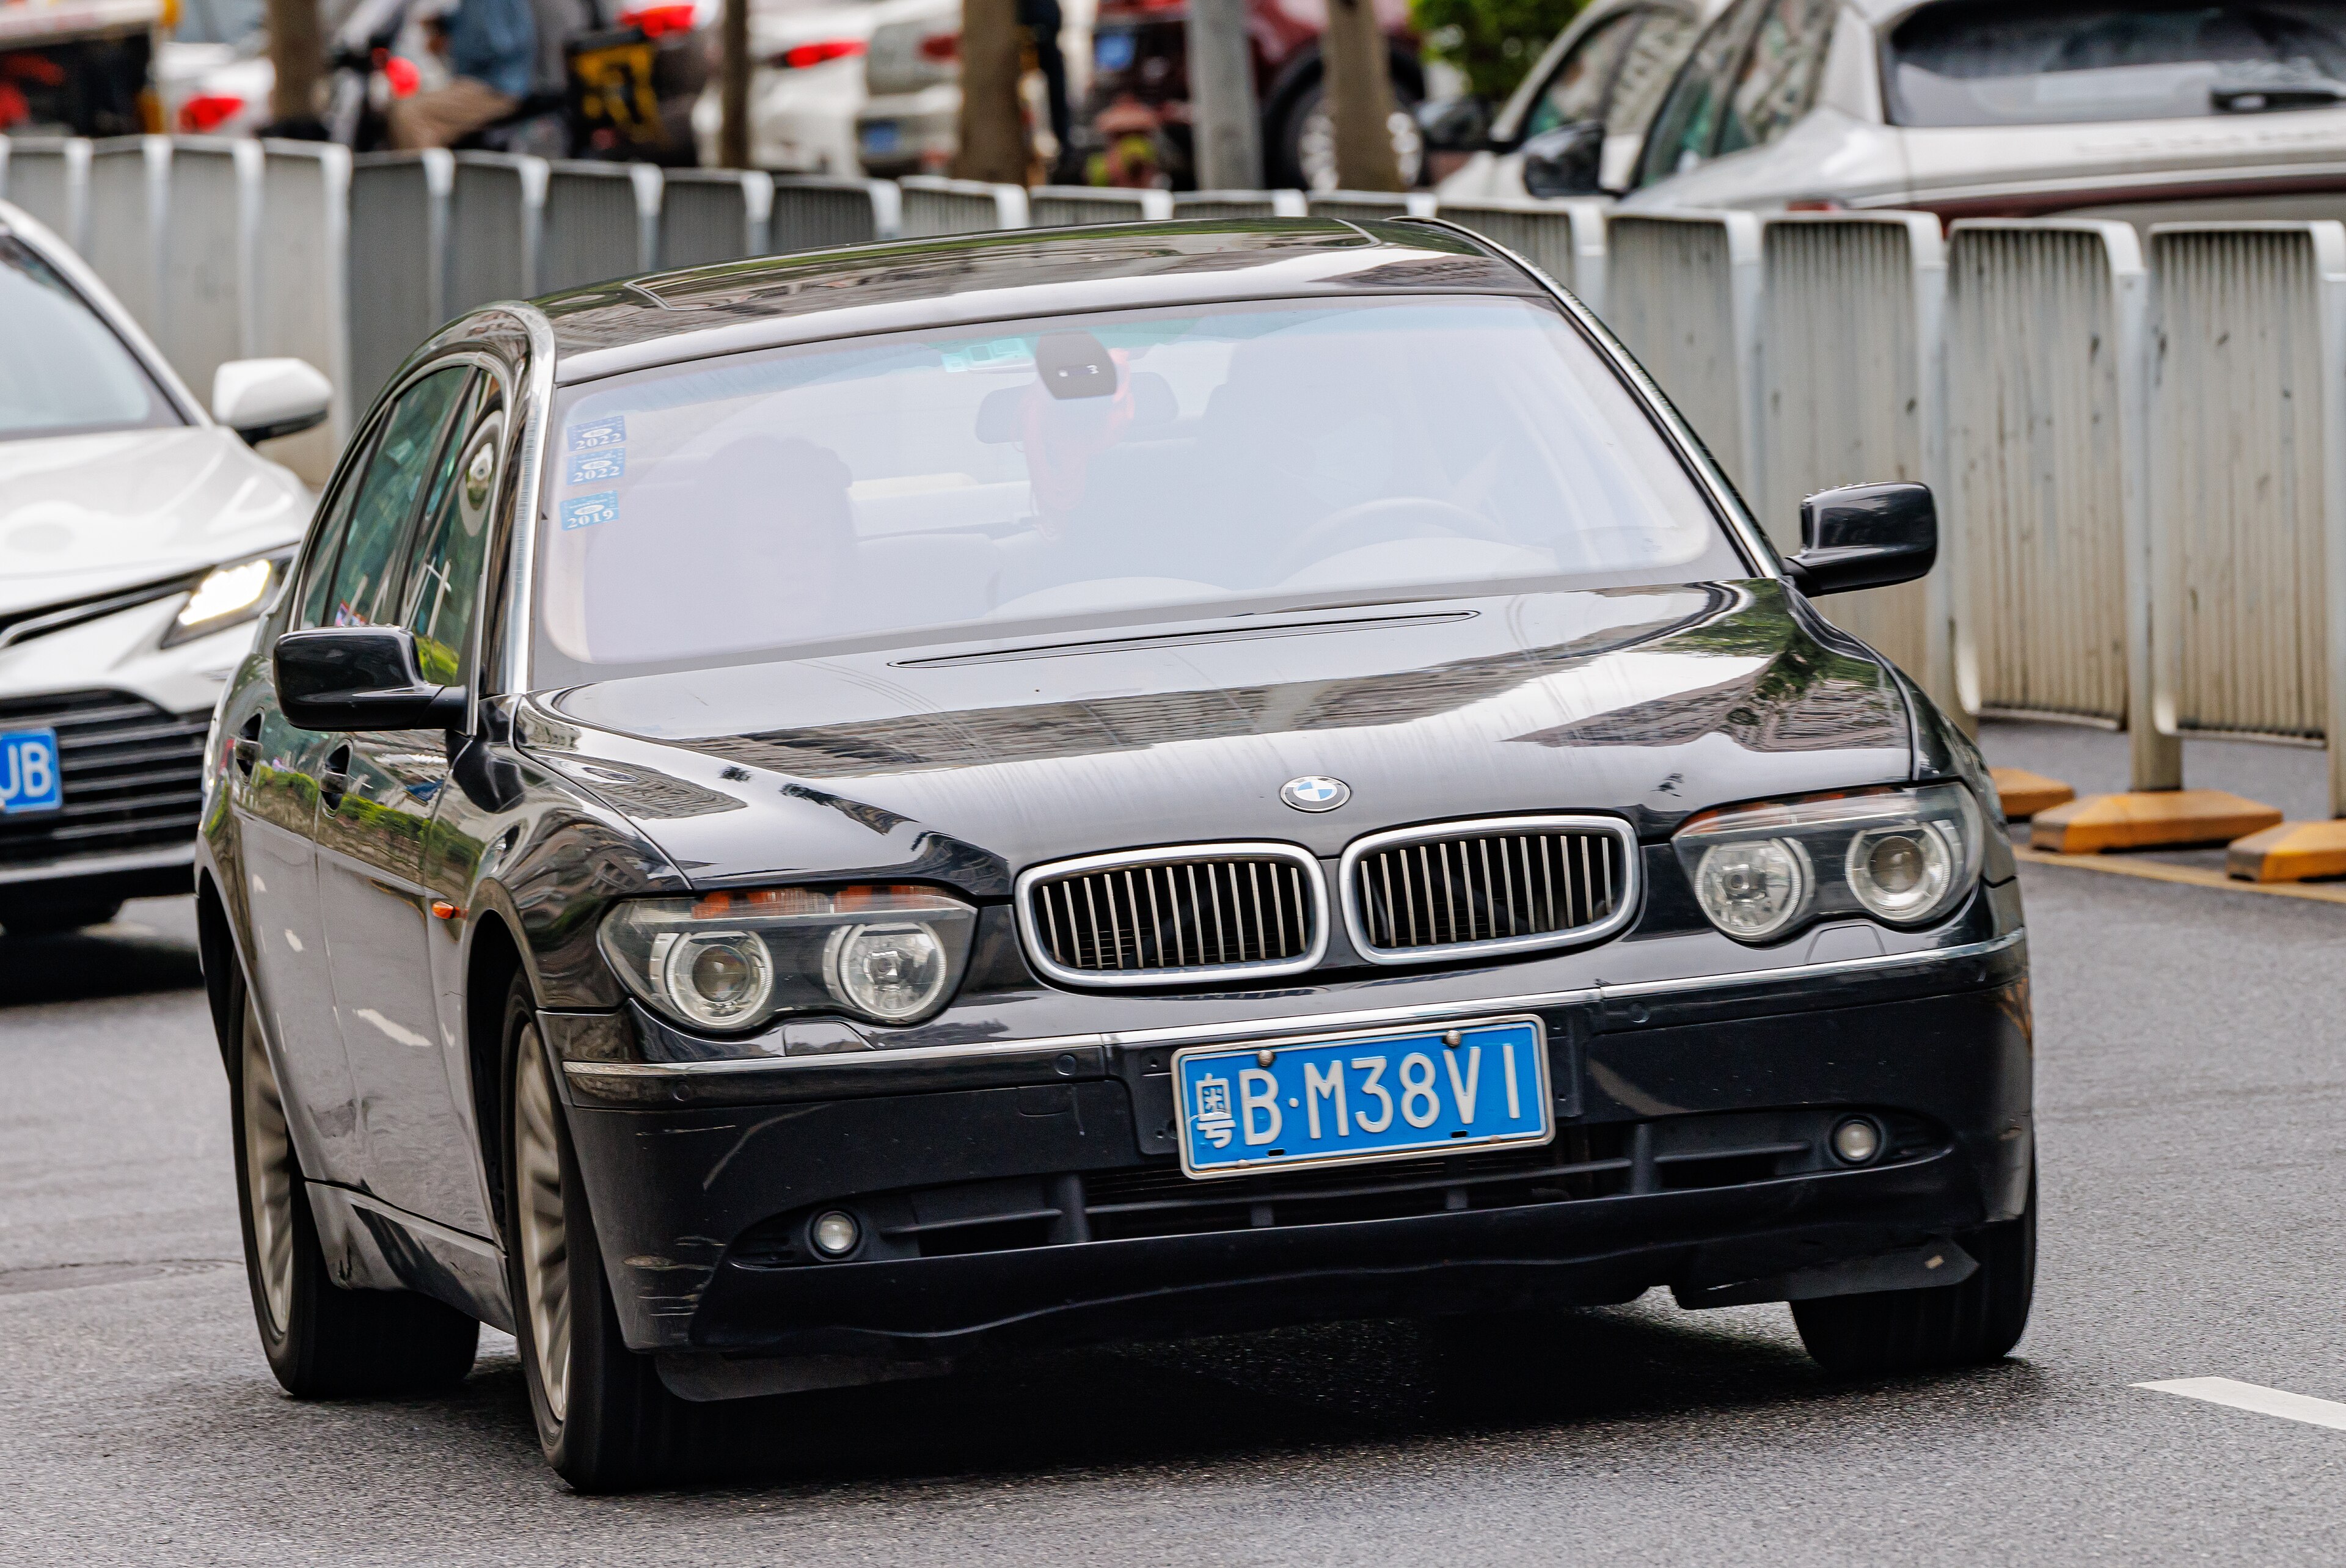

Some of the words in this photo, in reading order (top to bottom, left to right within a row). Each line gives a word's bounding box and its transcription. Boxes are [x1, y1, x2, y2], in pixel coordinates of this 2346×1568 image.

[576, 432, 622, 450] 2022
[572, 466, 620, 483] 2022
[567, 509, 614, 528] 2019
